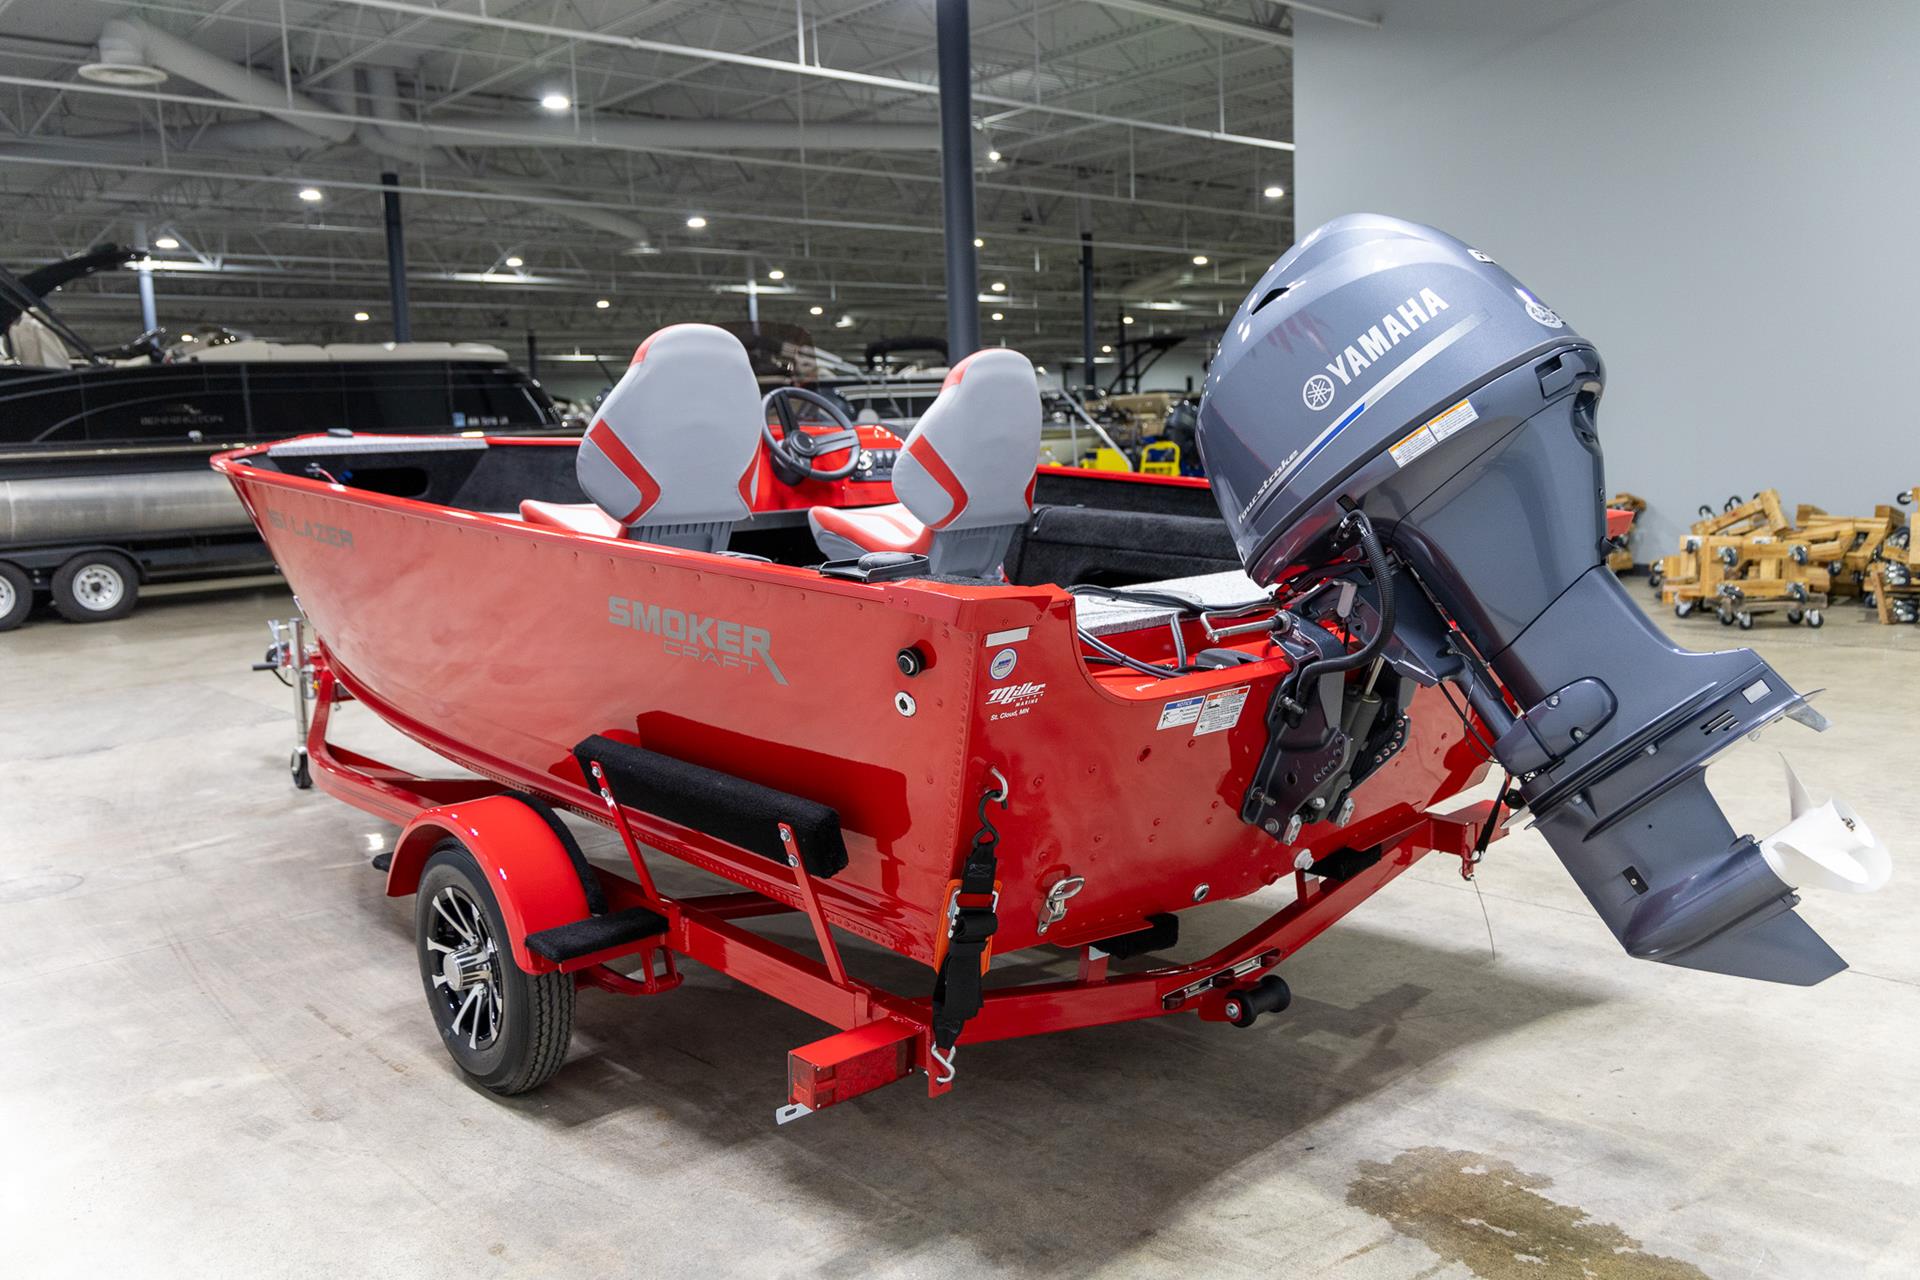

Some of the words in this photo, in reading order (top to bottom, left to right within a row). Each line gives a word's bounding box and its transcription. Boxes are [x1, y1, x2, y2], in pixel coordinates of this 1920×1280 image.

[1325, 287, 1450, 386] YAMAHA
[1238, 449, 1299, 524] fourstroke
[608, 595, 788, 686] SMOKER
[663, 640, 759, 674] CRAFT
[985, 682, 1046, 705] Miller
[1000, 710, 1018, 719] Cloud,
[1019, 707, 1030, 715] MN
